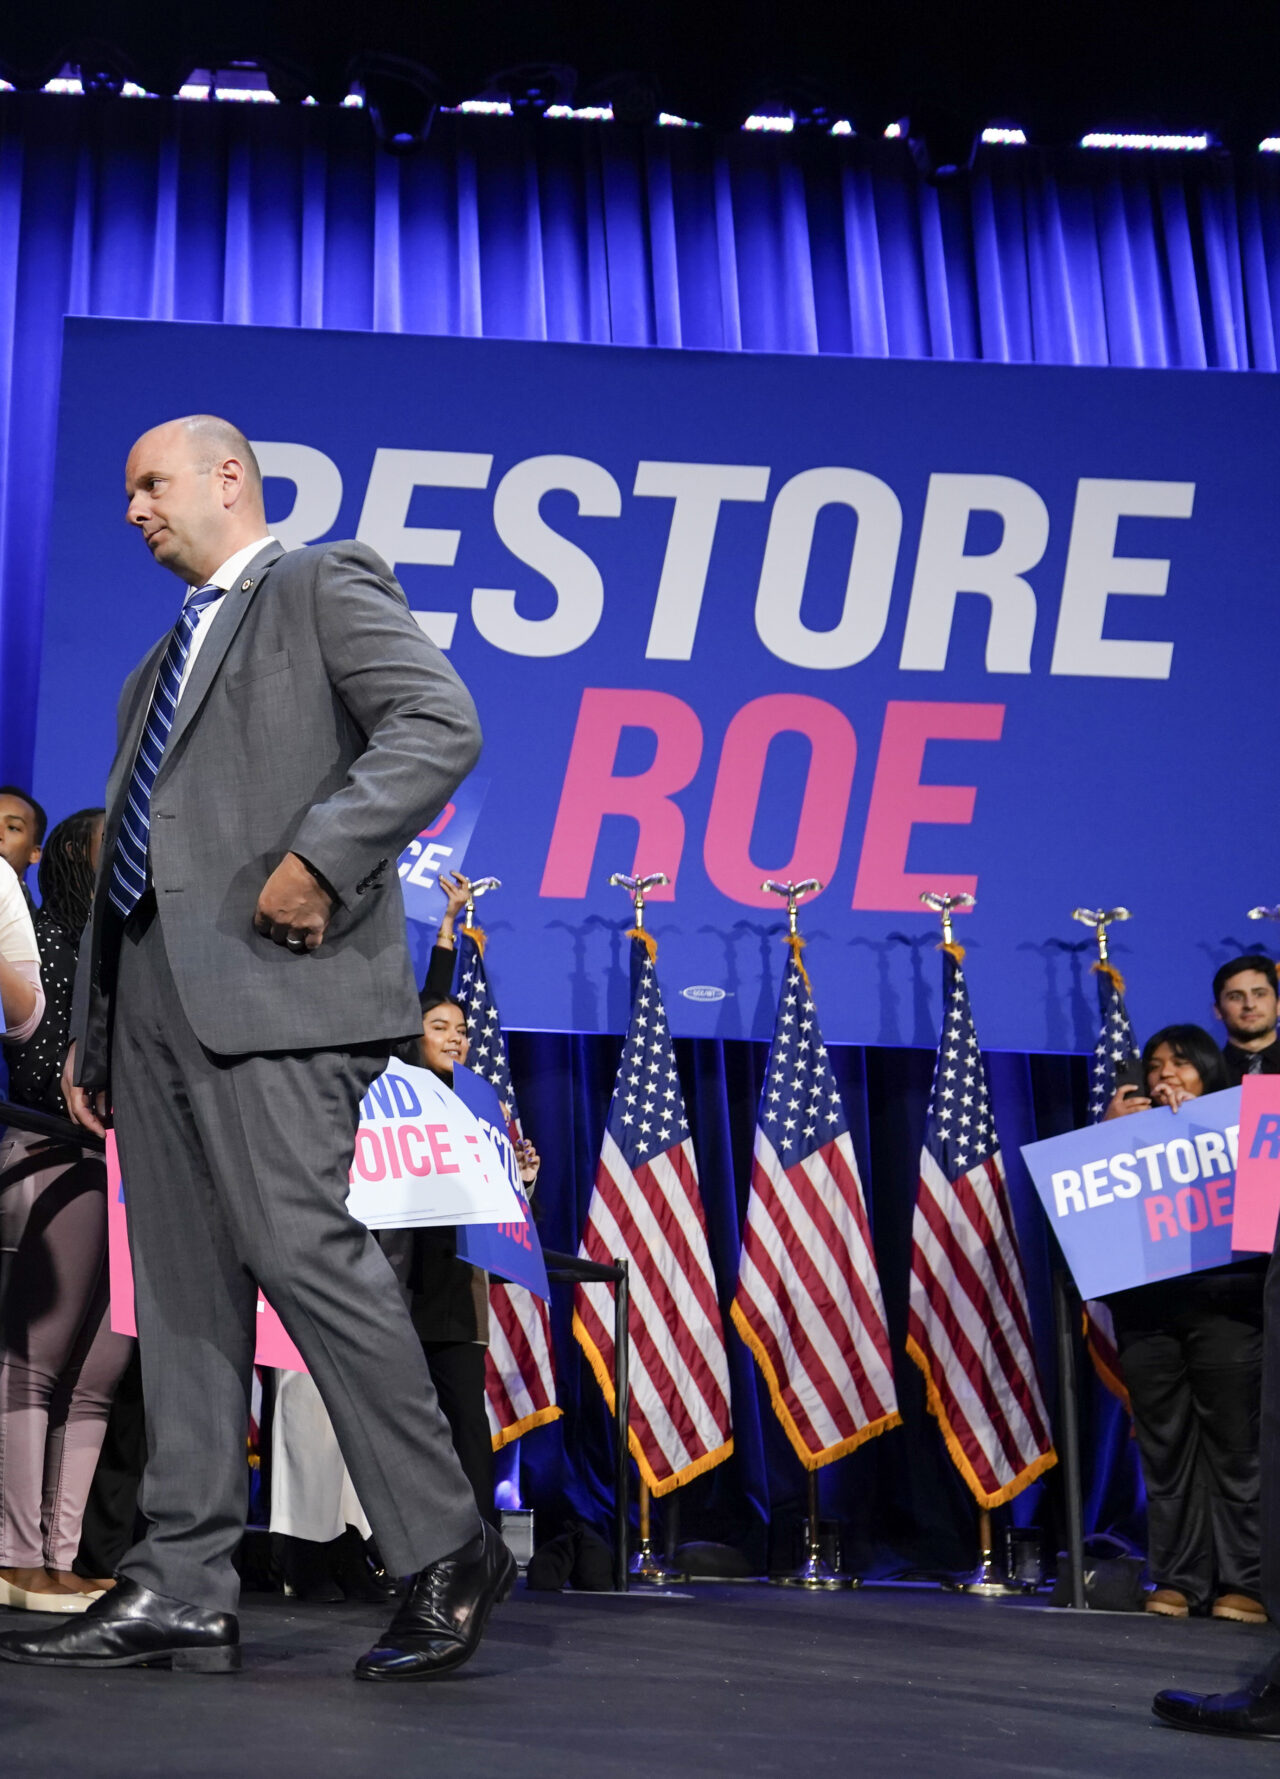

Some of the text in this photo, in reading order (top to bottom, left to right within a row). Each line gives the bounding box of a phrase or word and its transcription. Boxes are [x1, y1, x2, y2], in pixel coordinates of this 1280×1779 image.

[539, 688, 1005, 914] ROE
[348, 1124, 461, 1185] OICE
[1144, 1178, 1233, 1243] ROE
